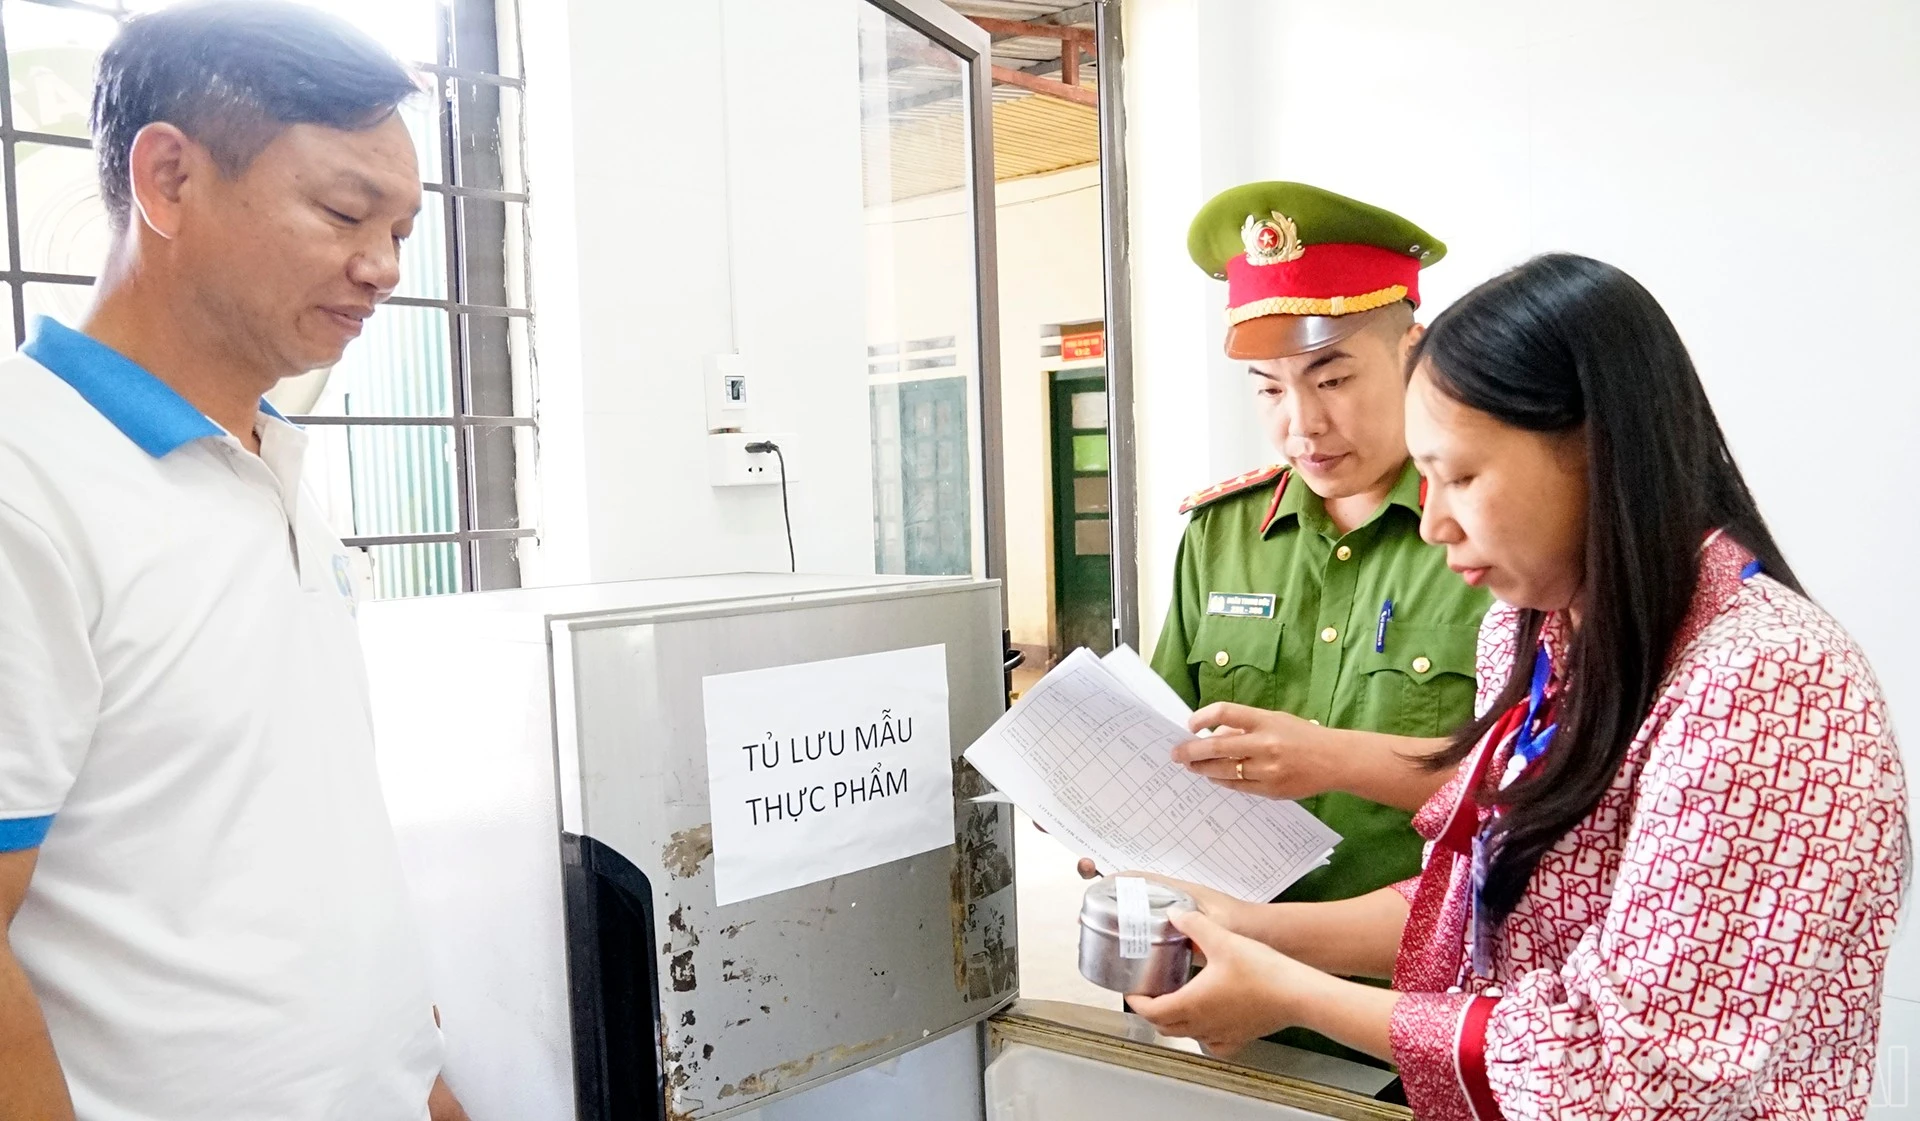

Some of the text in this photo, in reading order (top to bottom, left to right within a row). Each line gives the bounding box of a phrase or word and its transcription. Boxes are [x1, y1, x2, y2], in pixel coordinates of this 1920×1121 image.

[742, 708, 912, 772] TỦ LƯU MẪU
[745, 762, 908, 826] THỰC PHẨM
